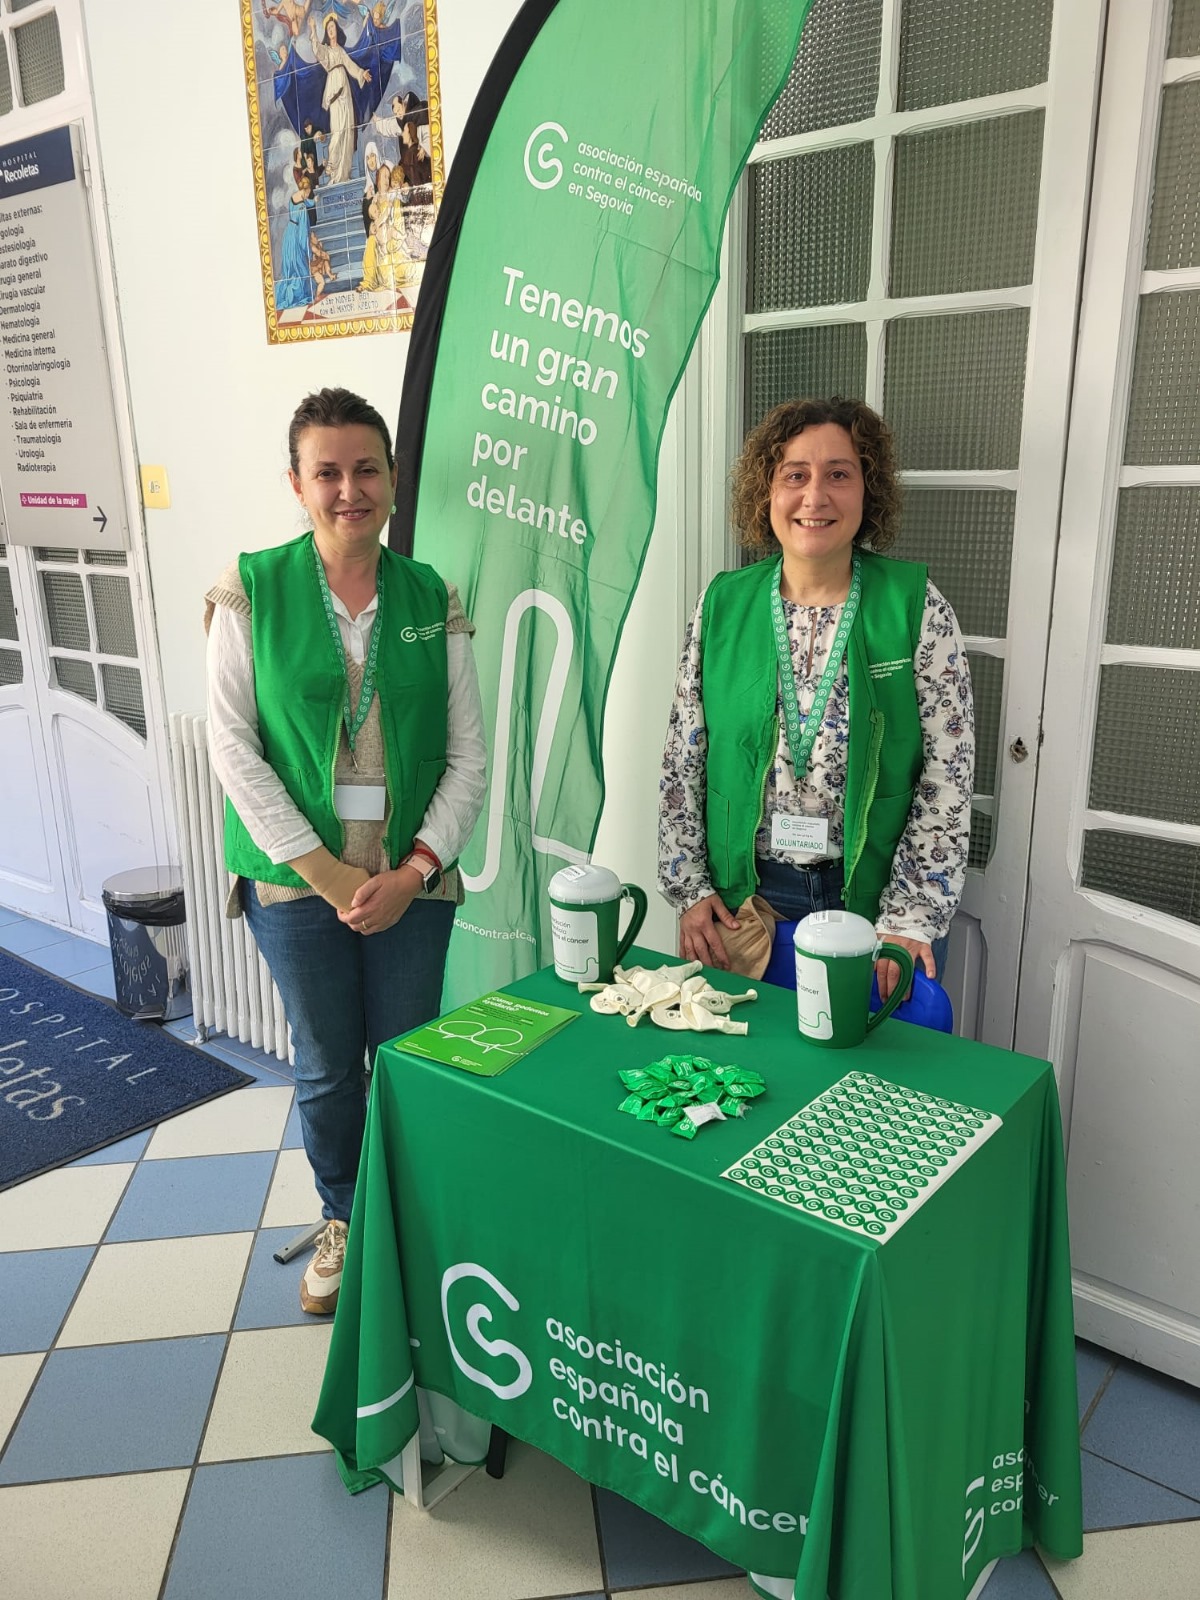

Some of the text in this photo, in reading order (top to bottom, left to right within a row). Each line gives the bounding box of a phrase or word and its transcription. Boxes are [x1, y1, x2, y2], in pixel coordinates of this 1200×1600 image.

[2, 151, 37, 167] HOSPITAL
[4, 163, 40, 183] Recoletas
[578, 141, 702, 202] asociación española
[573, 161, 675, 209] contra el cáncer
[568, 181, 634, 215] en Segovia
[18, 252, 48, 267] digestivo
[17, 267, 42, 284] general
[19, 283, 46, 297] vascular
[503, 266, 650, 358] Tenemos
[2, 329, 56, 345] Medicina general
[4, 345, 56, 359] Medicina interna
[490, 330, 619, 399] un gran
[12, 404, 57, 416] Rehabilitación
[481, 383, 598, 446] camino
[14, 421, 28, 431] Sala
[28, 420, 37, 430] de
[472, 432, 528, 471] por
[17, 462, 57, 474] Radioterapia
[27, 495, 80, 506] Unidad de la mujer
[466, 475, 588, 545] delante
[775, 838, 824, 850] VOLUNTARIADO
[546, 1317, 710, 1413] asociación
[549, 1356, 684, 1445] española
[552, 1397, 810, 1536] contra el cáncer
